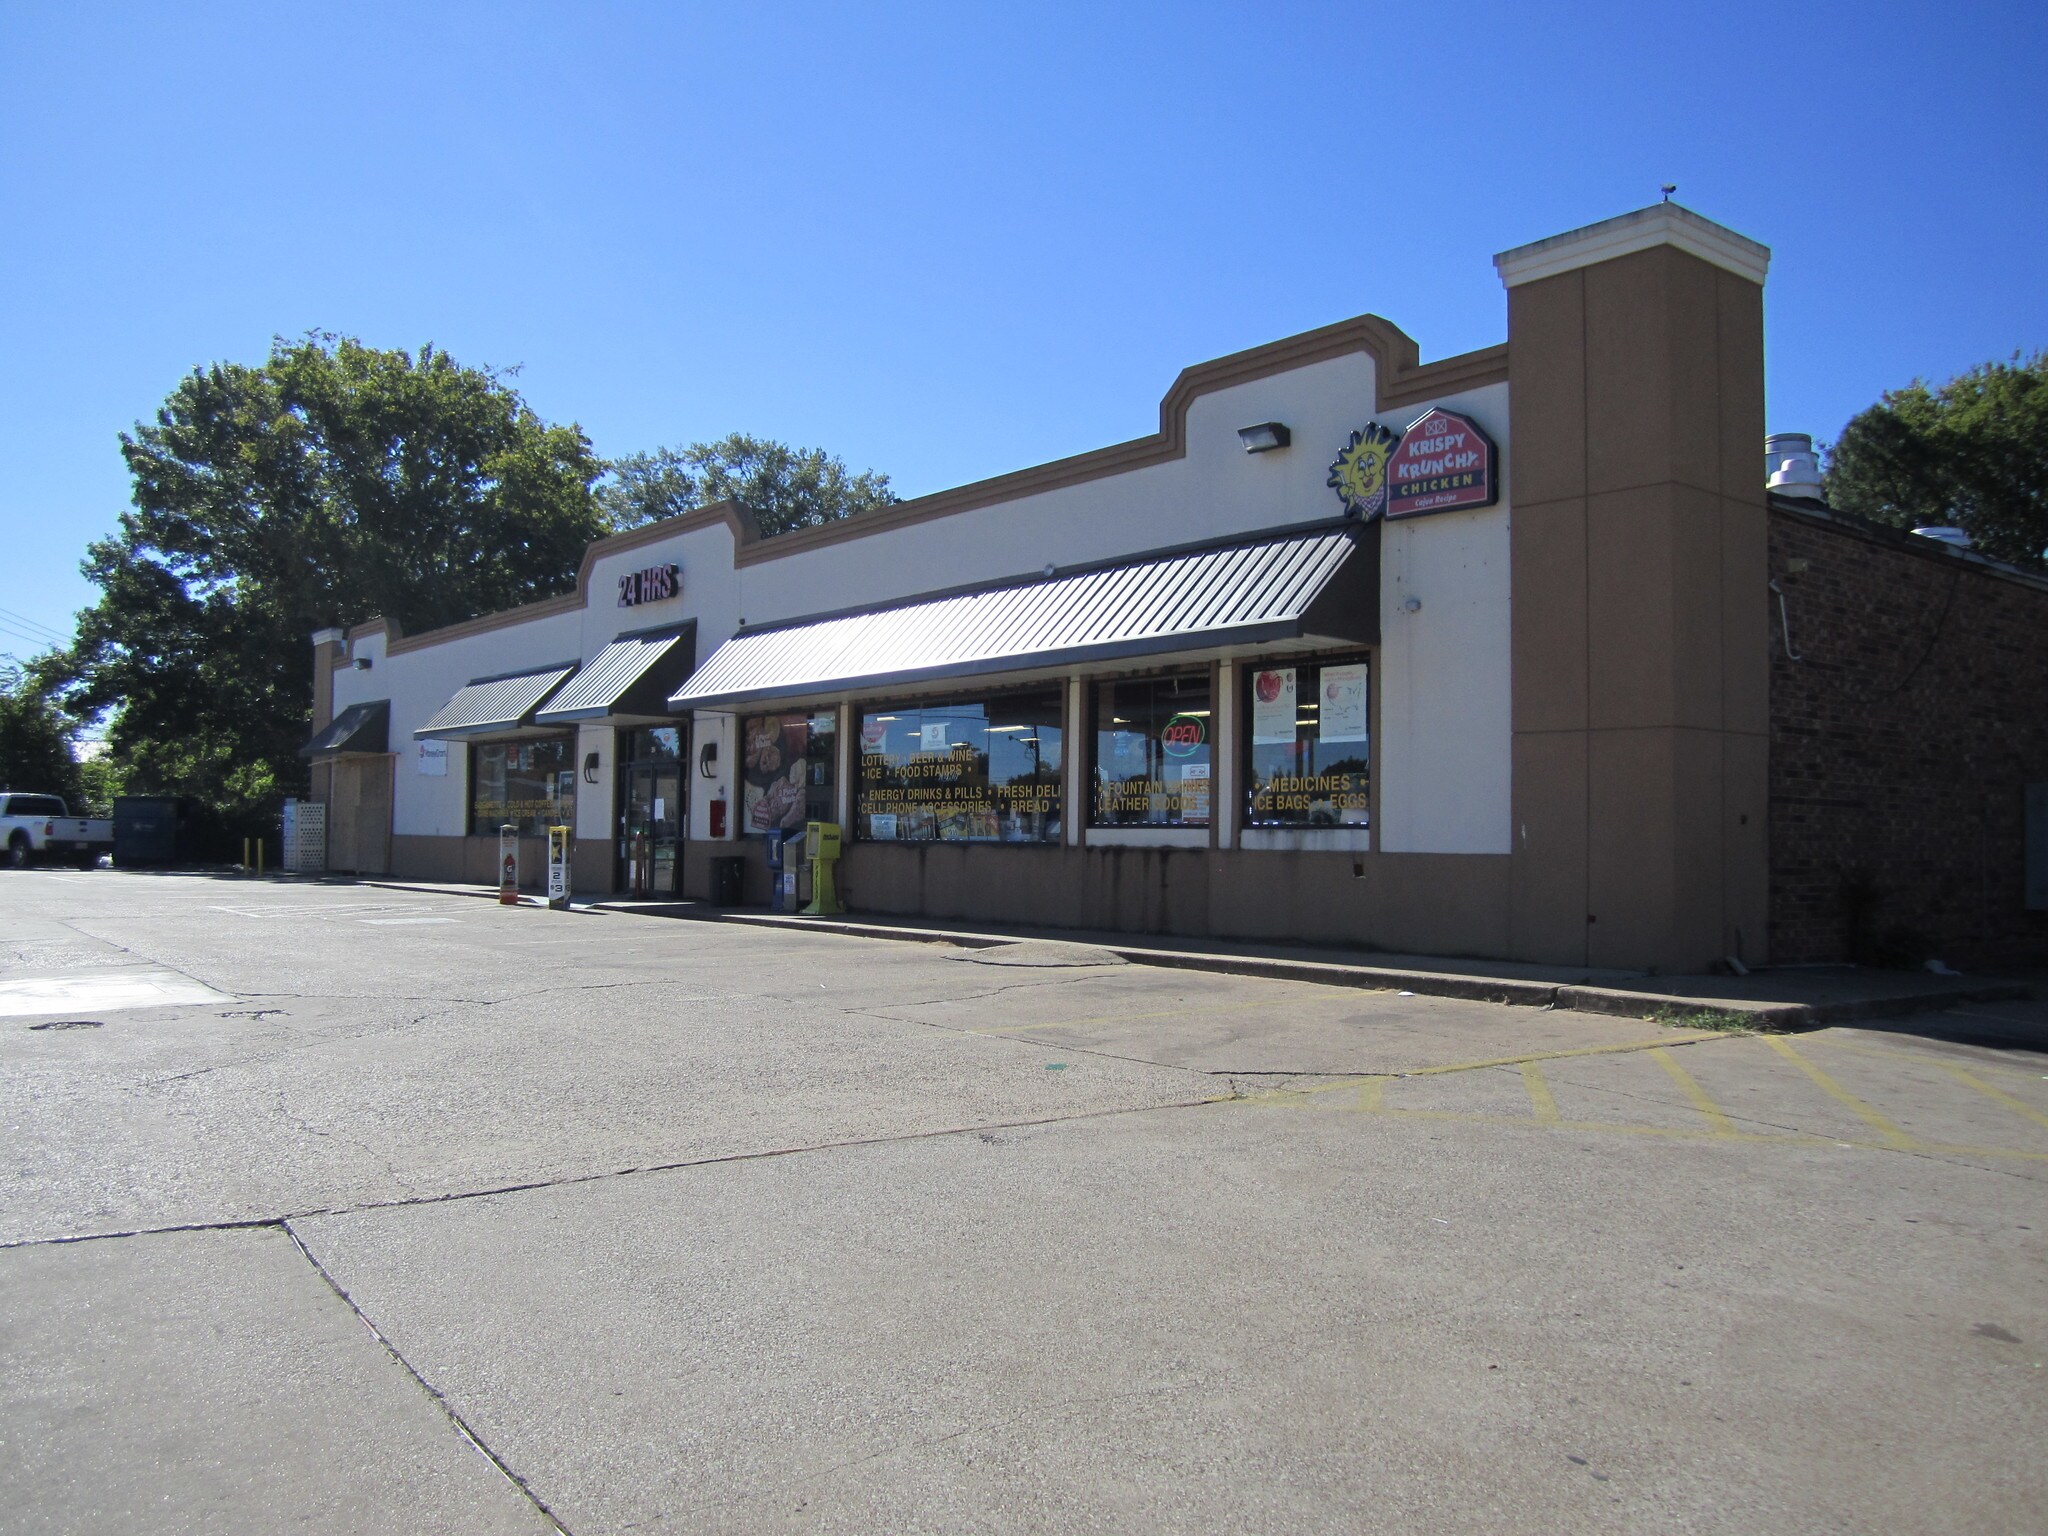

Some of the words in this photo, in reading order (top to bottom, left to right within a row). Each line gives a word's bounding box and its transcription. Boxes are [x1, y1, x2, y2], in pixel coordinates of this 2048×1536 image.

[1408, 433, 1466, 458] KRISPY
[1398, 451, 1479, 480] KRUNCHY
[1401, 474, 1473, 496] CHICKEN
[617, 573, 640, 608] 24
[640, 563, 679, 602] HRS
[1164, 725, 1201, 746] OPEN
[861, 754, 898, 767] LOTTERY
[909, 752, 935, 764] BEER
[937, 752, 944, 763] &
[948, 750, 973, 762] WINE
[867, 768, 882, 779] ICE
[894, 766, 921, 778] FOOD
[923, 764, 963, 777] STAMPS
[1108, 781, 1162, 795] FOUNTAIN
[1268, 775, 1350, 792] MEDICINES
[869, 789, 905, 801] ENERGY
[907, 788, 943, 800] DRINKS
[945, 788, 951, 799] &
[954, 787, 983, 799] PILLS
[998, 785, 1033, 798] FRESH
[1036, 785, 1061, 798] DELI
[1254, 796, 1273, 810] ICE
[1276, 794, 1311, 810] BAGS
[1329, 793, 1366, 809] EGGS
[861, 803, 883, 814] CELL
[886, 802, 918, 814] PHONE
[920, 801, 992, 813] ACCESSORIES
[1011, 800, 1050, 812] BREAD
[1098, 797, 1150, 811] LEATHER
[552, 871, 561, 880] 2
